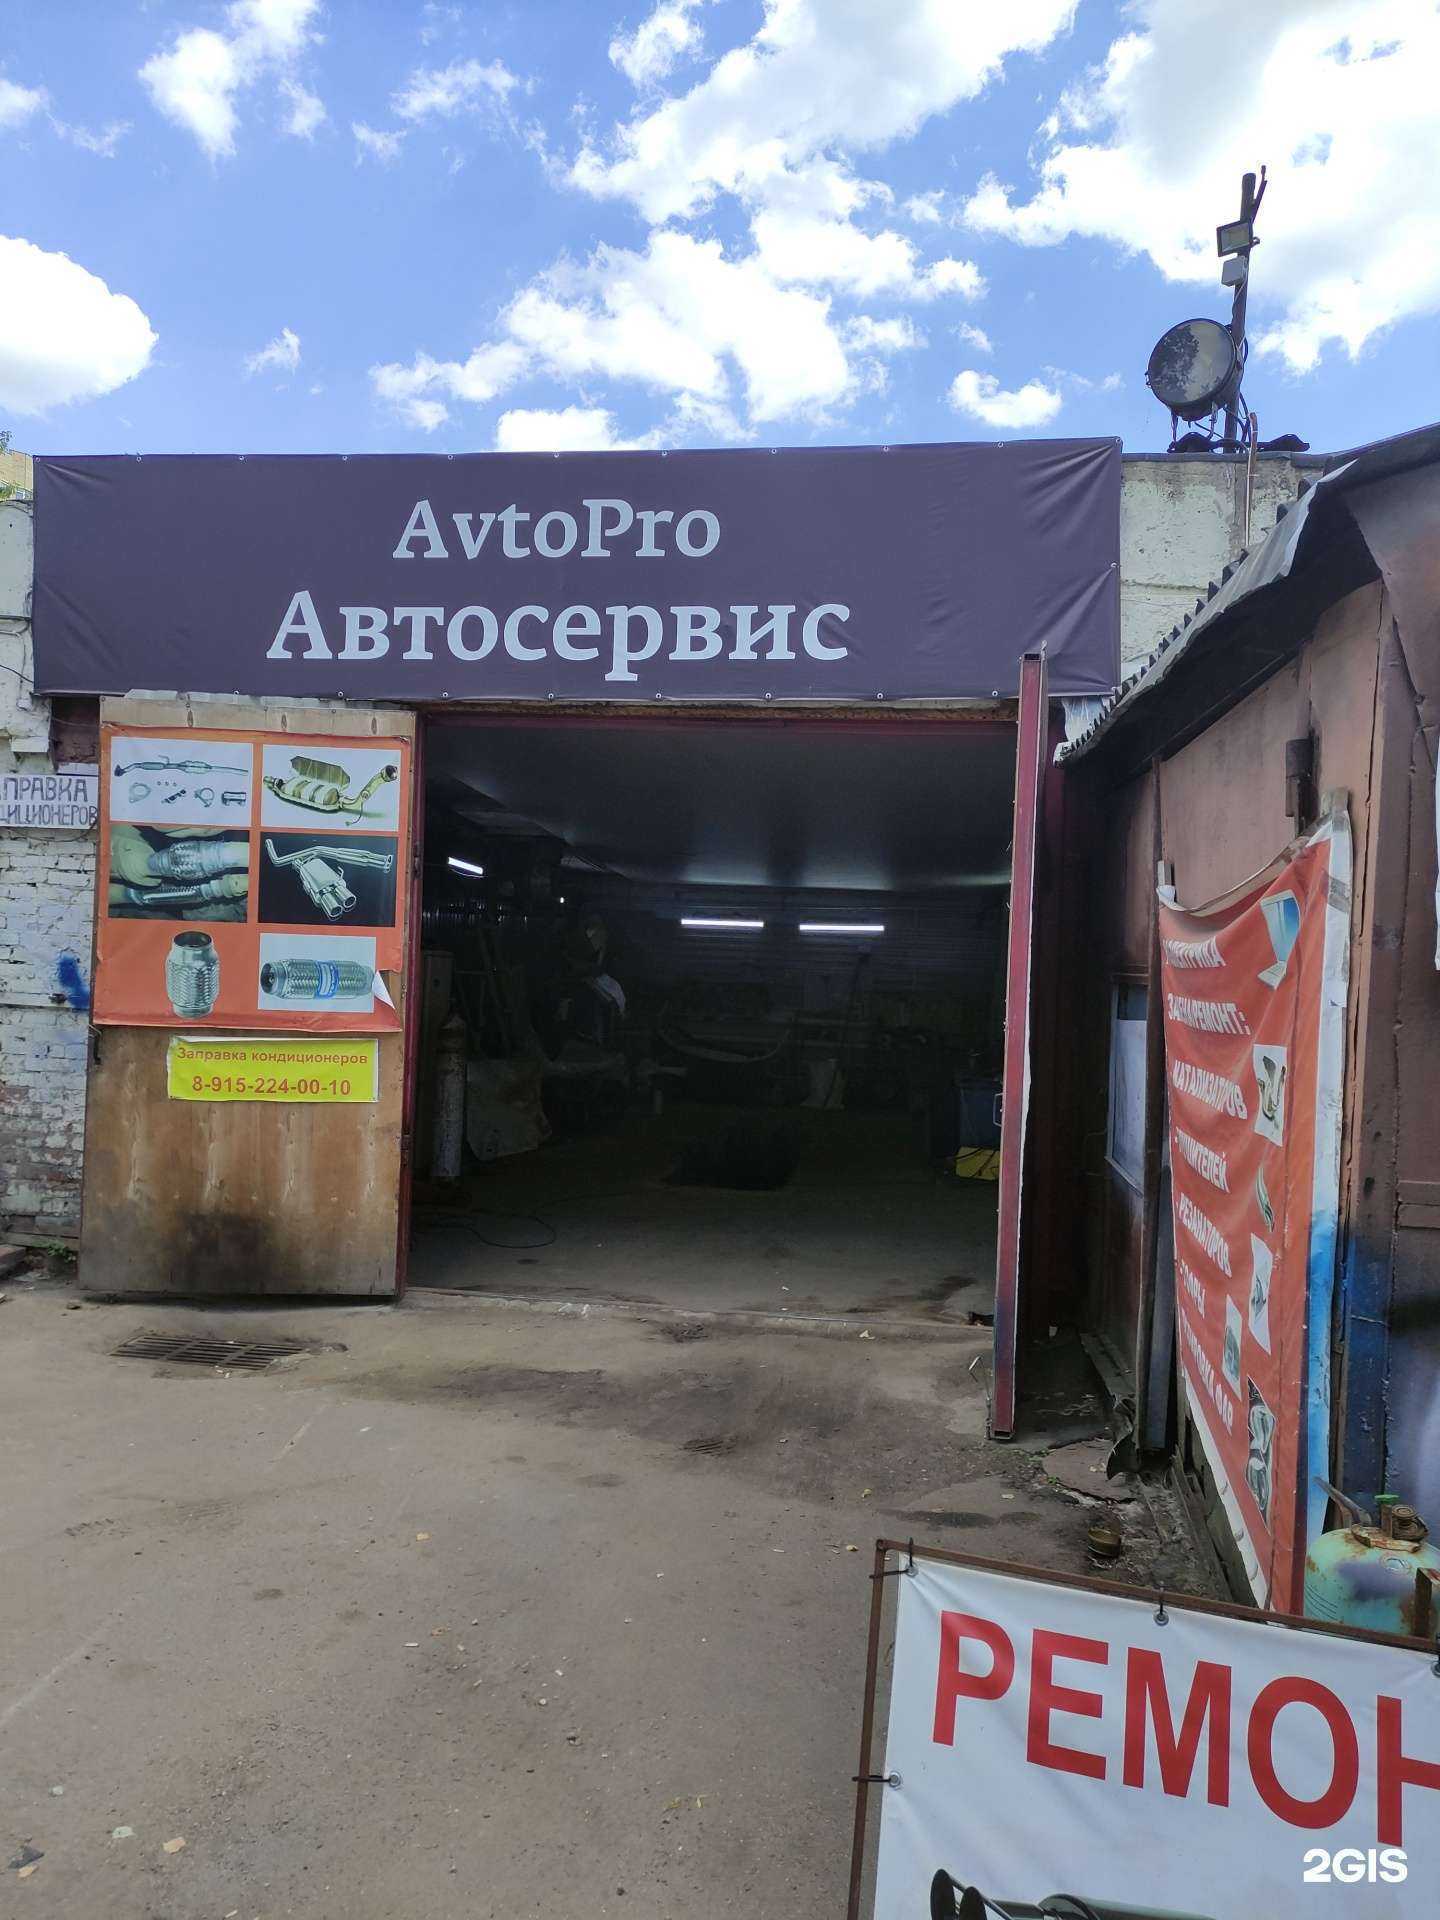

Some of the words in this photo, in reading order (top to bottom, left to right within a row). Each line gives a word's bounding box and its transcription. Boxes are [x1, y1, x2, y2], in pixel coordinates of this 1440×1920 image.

[392, 499, 721, 560] AvtoPro
[266, 590, 849, 681] Автосервис
[0, 776, 88, 802] ПРАВКА
[177, 1047, 247, 1062] Заправка
[251, 1052, 368, 1066] кондиционеров
[191, 1076, 351, 1096] 8-915-224-00-10
[932, 1609, 1440, 1847] РЕМОН
